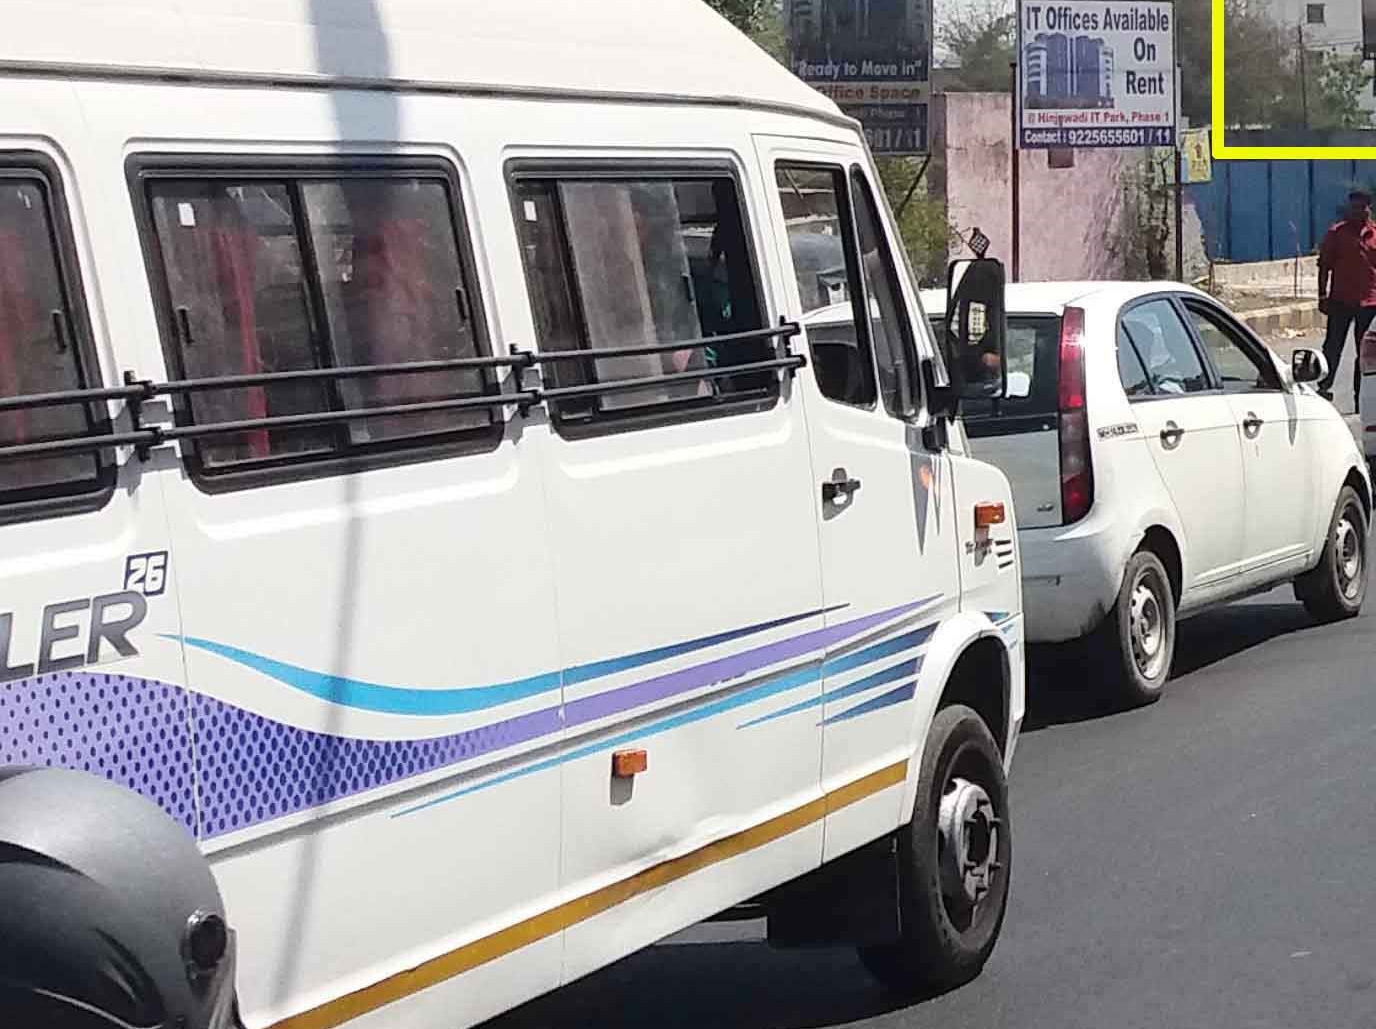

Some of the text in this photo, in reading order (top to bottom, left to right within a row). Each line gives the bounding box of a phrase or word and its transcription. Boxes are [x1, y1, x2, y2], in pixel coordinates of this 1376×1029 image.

[1026, 6, 1169, 32] IT Offices Available
[1133, 37, 1156, 62] On
[844, 61, 857, 76] to
[861, 60, 898, 76] Move
[1126, 70, 1164, 95] Rent
[1038, 112, 1088, 126] Hinjewadi
[1091, 112, 1100, 123] IT
[1131, 111, 1162, 122] Phase
[1068, 129, 1144, 145] 9225655601
[1156, 128, 1171, 144] 11
[124, 551, 169, 597] 26
